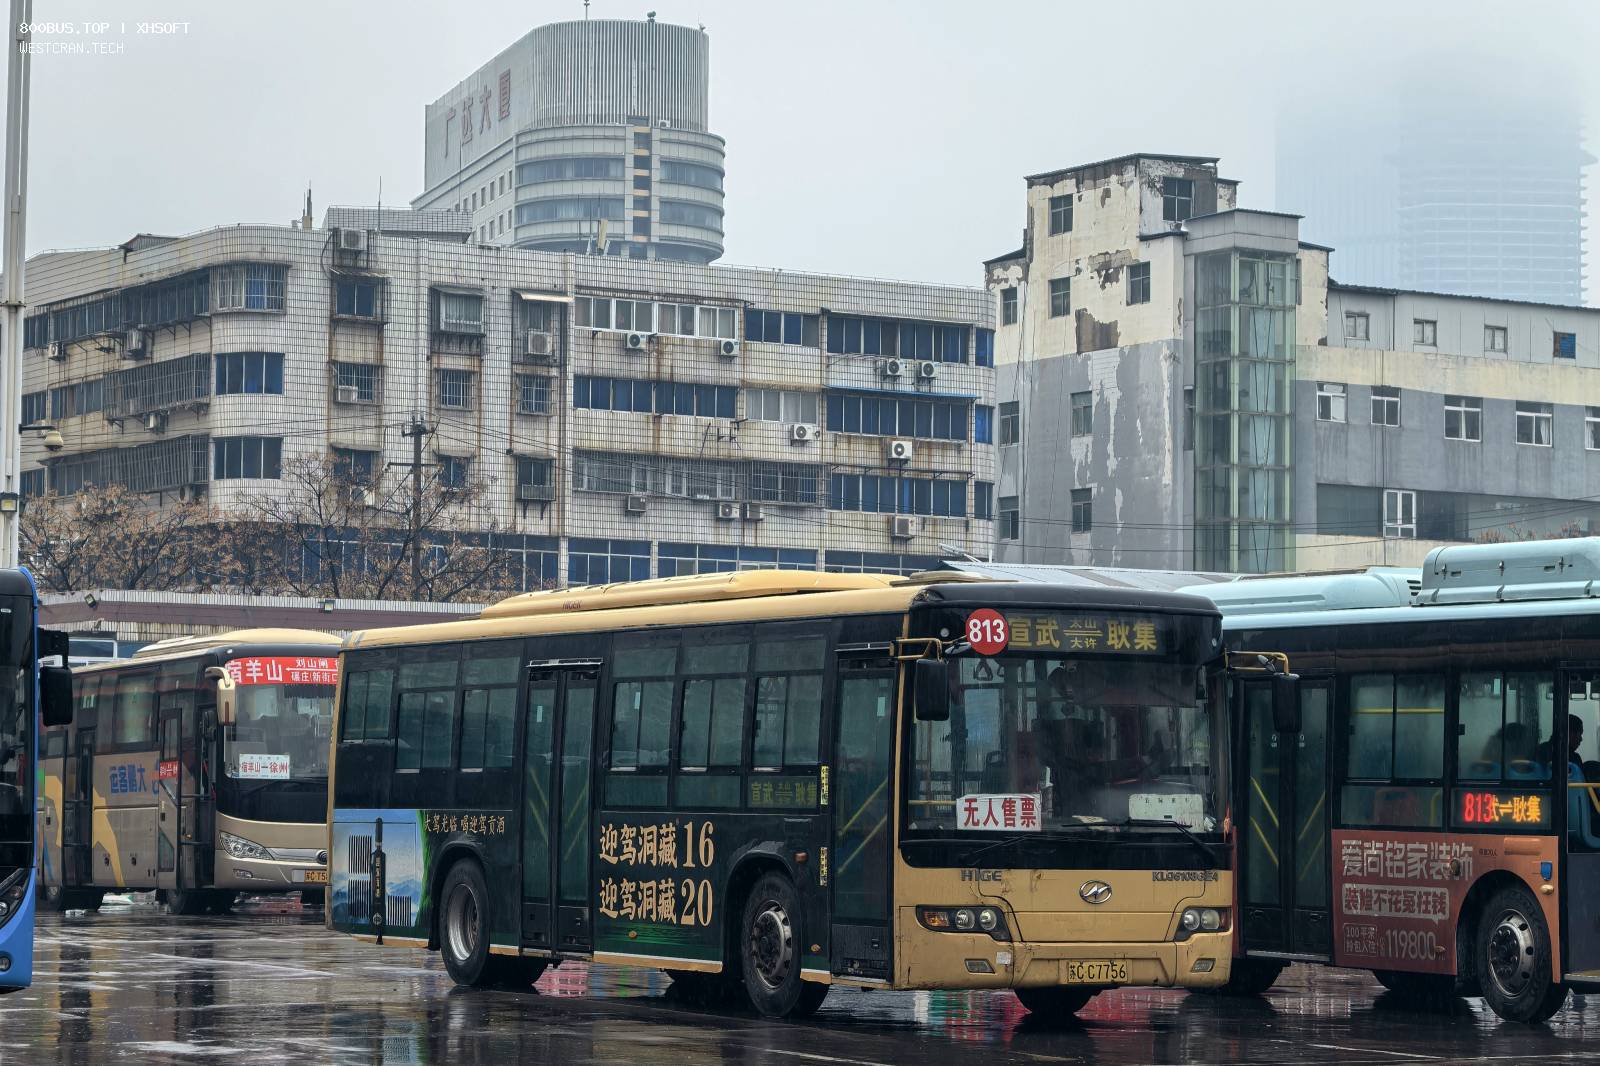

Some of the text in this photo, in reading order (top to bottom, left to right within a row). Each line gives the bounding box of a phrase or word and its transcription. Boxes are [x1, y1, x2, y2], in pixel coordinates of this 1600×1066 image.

[969, 618, 1006, 643] 813
[1008, 617, 1157, 650] 宣武 耿集
[1070, 637, 1097, 649] 大许
[963, 797, 1036, 828] 无人售票
[1464, 792, 1492, 823] 813
[1341, 839, 1473, 881] 爱尚铭家装饰
[1386, 929, 1436, 960] 119800
